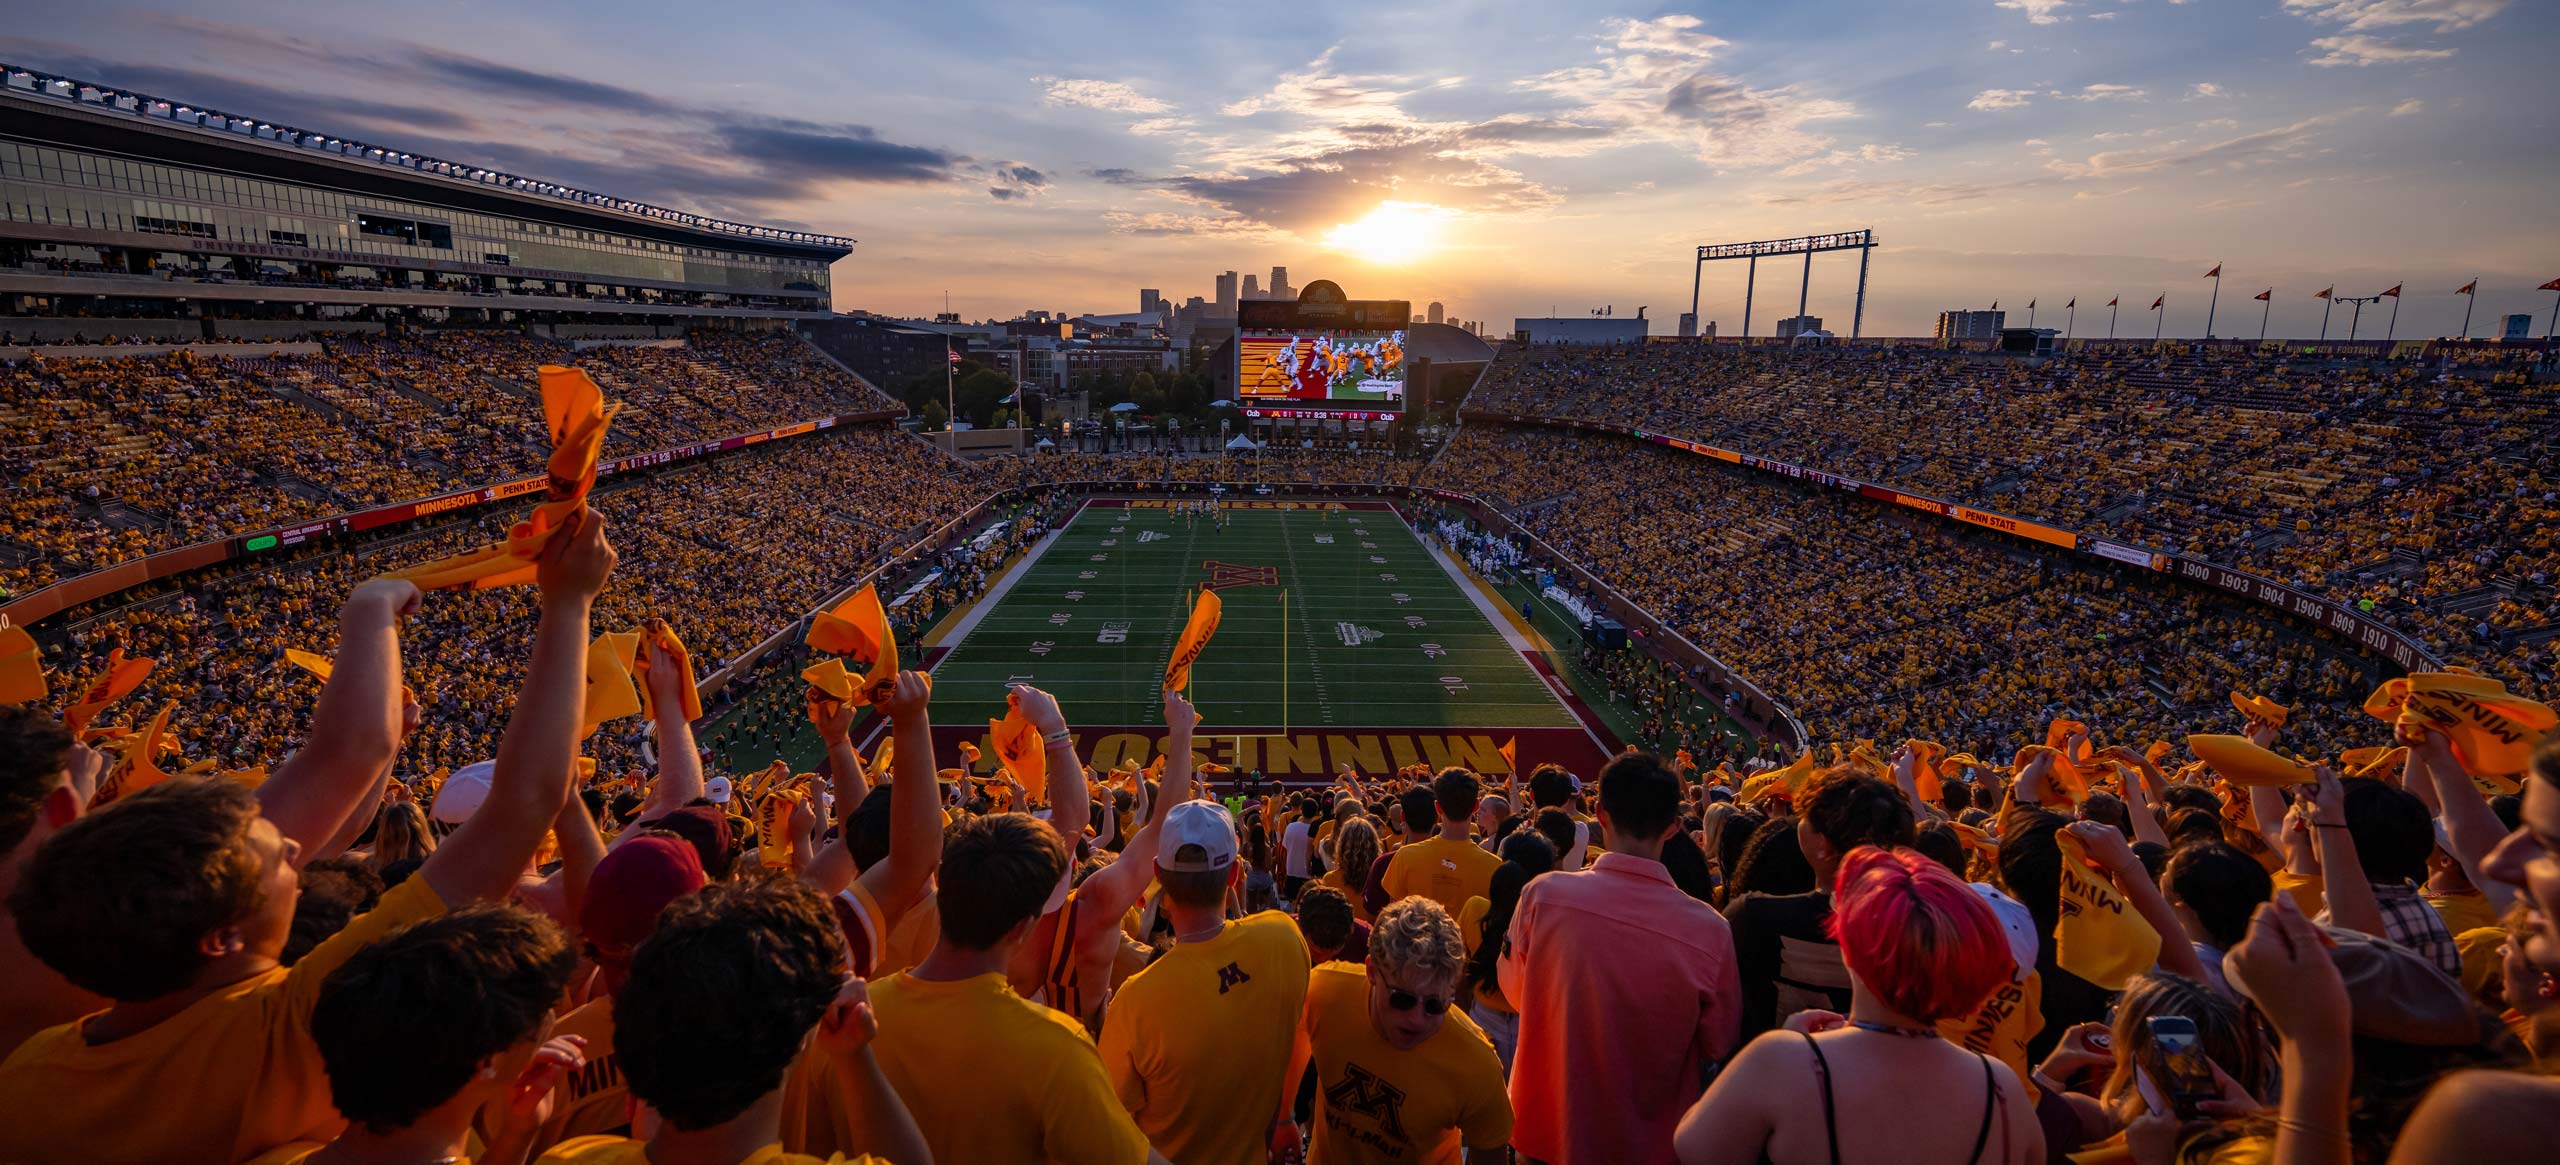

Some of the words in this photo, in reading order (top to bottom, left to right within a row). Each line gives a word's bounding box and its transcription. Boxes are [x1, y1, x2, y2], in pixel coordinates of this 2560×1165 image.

[193, 240, 293, 257] UNIVERSITY
[303, 250, 318, 258] OF
[328, 251, 400, 265] MINNESOTA
[2337, 346, 2379, 354] FOOTBALL
[1380, 413, 1394, 421] Cub
[415, 493, 478, 516] MINNESOTA
[485, 489, 495, 498] VS
[503, 483, 525, 495] PENN
[527, 478, 549, 490] STATE
[1131, 501, 1349, 510] MINESOTA
[1896, 494, 1942, 514] MINNESOTA
[1948, 506, 1958, 515] VS
[1965, 510, 1988, 524] PENN
[1990, 516, 2016, 531] STATE
[282, 528, 301, 538] CENTRAL
[301, 523, 324, 534] ARKANSAS
[283, 535, 306, 545] MISSOURI
[2182, 561, 2210, 580] 1900
[2219, 572, 2249, 592] 1903
[1065, 590, 1087, 599] 40
[1390, 593, 1412, 602] 40
[2258, 584, 2285, 606] 1904
[2294, 597, 2323, 620] 1906
[1048, 613, 1072, 624] 30
[1403, 616, 1427, 627] 30
[2331, 611, 2355, 634] 1909
[1029, 640, 1056, 652] 20
[2361, 625, 2388, 650] 1910
[1420, 643, 1447, 656] 20
[2393, 642, 2412, 668] 1911
[1004, 674, 1034, 688] 10
[1439, 676, 1469, 691] 10
[973, 733, 1515, 775] MINNESO
[1217, 962, 1250, 994] M
[1326, 1062, 1408, 1143] M
